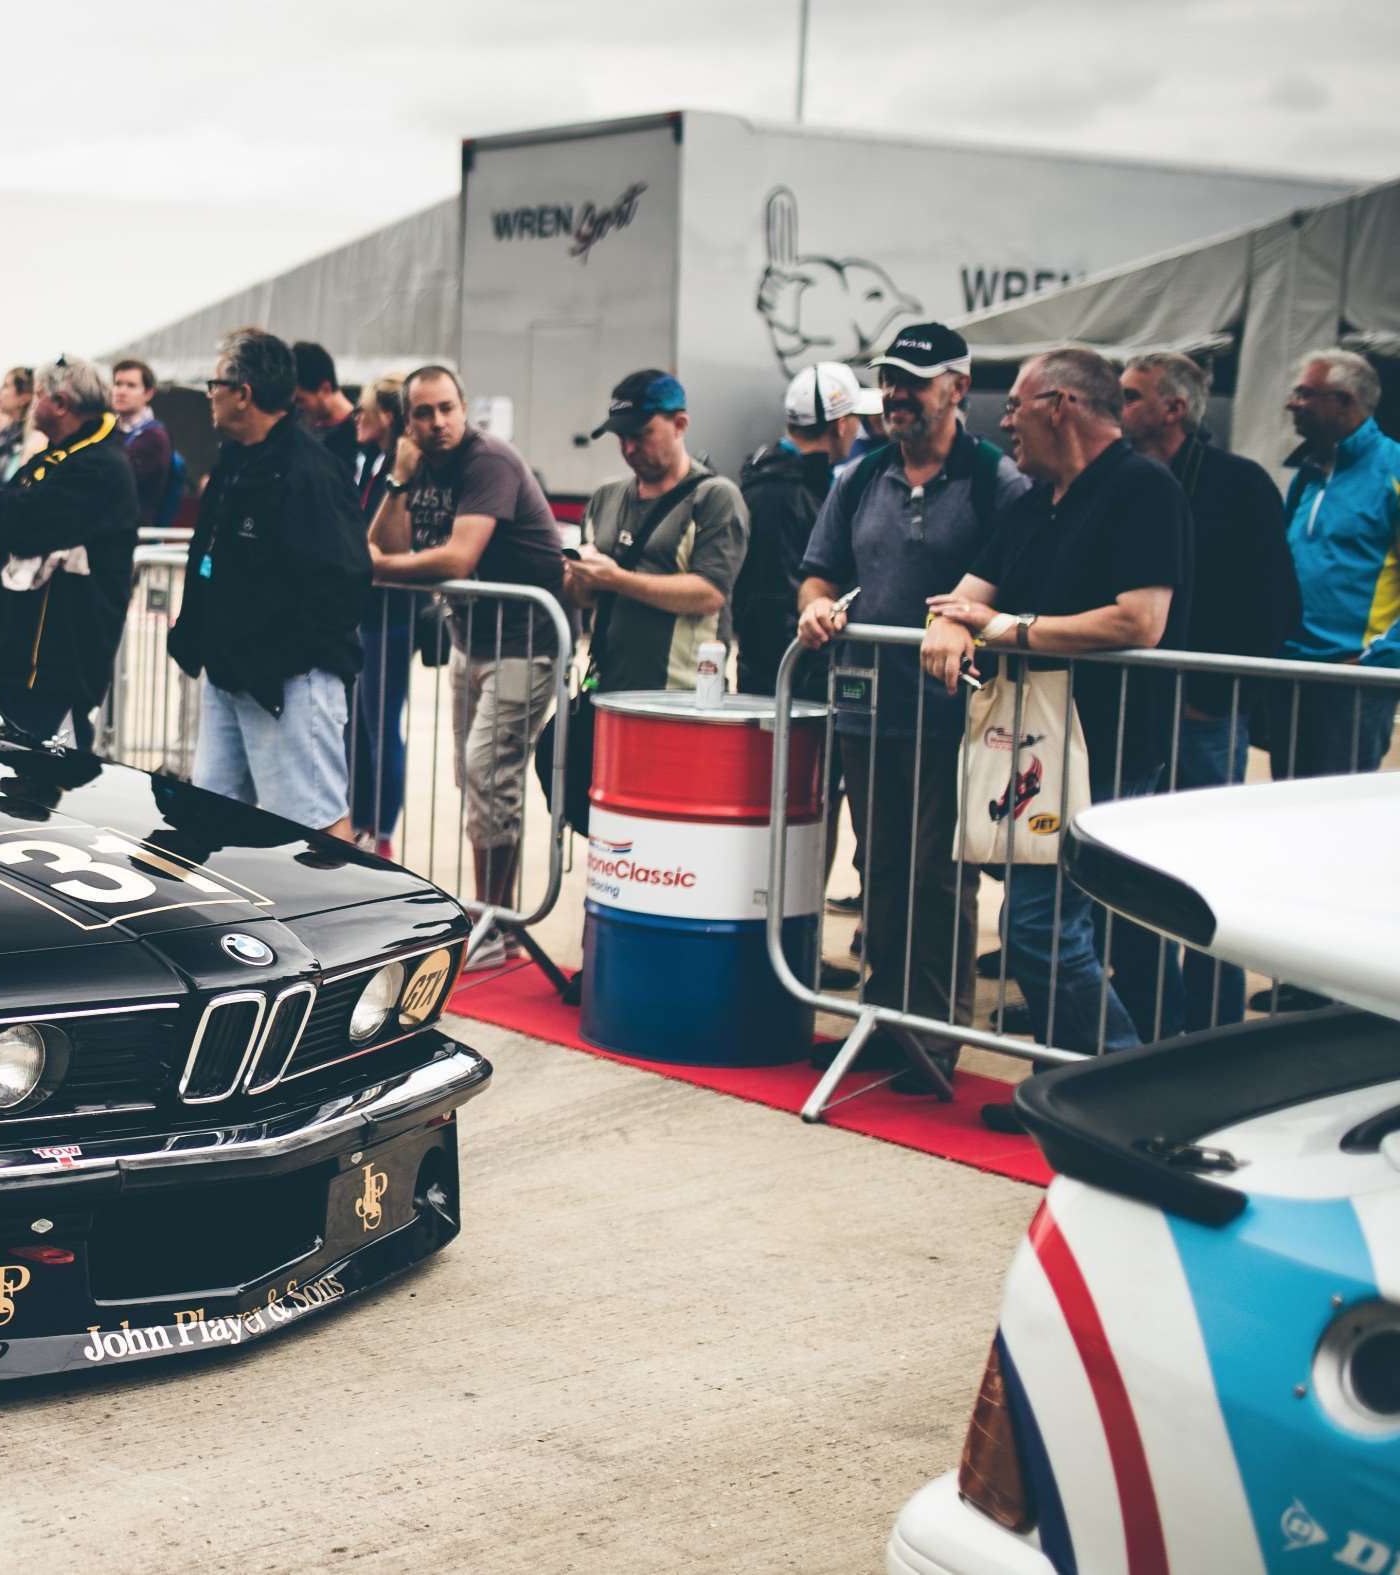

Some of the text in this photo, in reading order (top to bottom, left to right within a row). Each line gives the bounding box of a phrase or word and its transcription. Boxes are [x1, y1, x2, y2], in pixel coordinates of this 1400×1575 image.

[490, 205, 574, 241] WREN
[404, 966, 450, 1014] GTX
[37, 1147, 78, 1157] TOW
[84, 1274, 346, 1362] John Player & Sons
